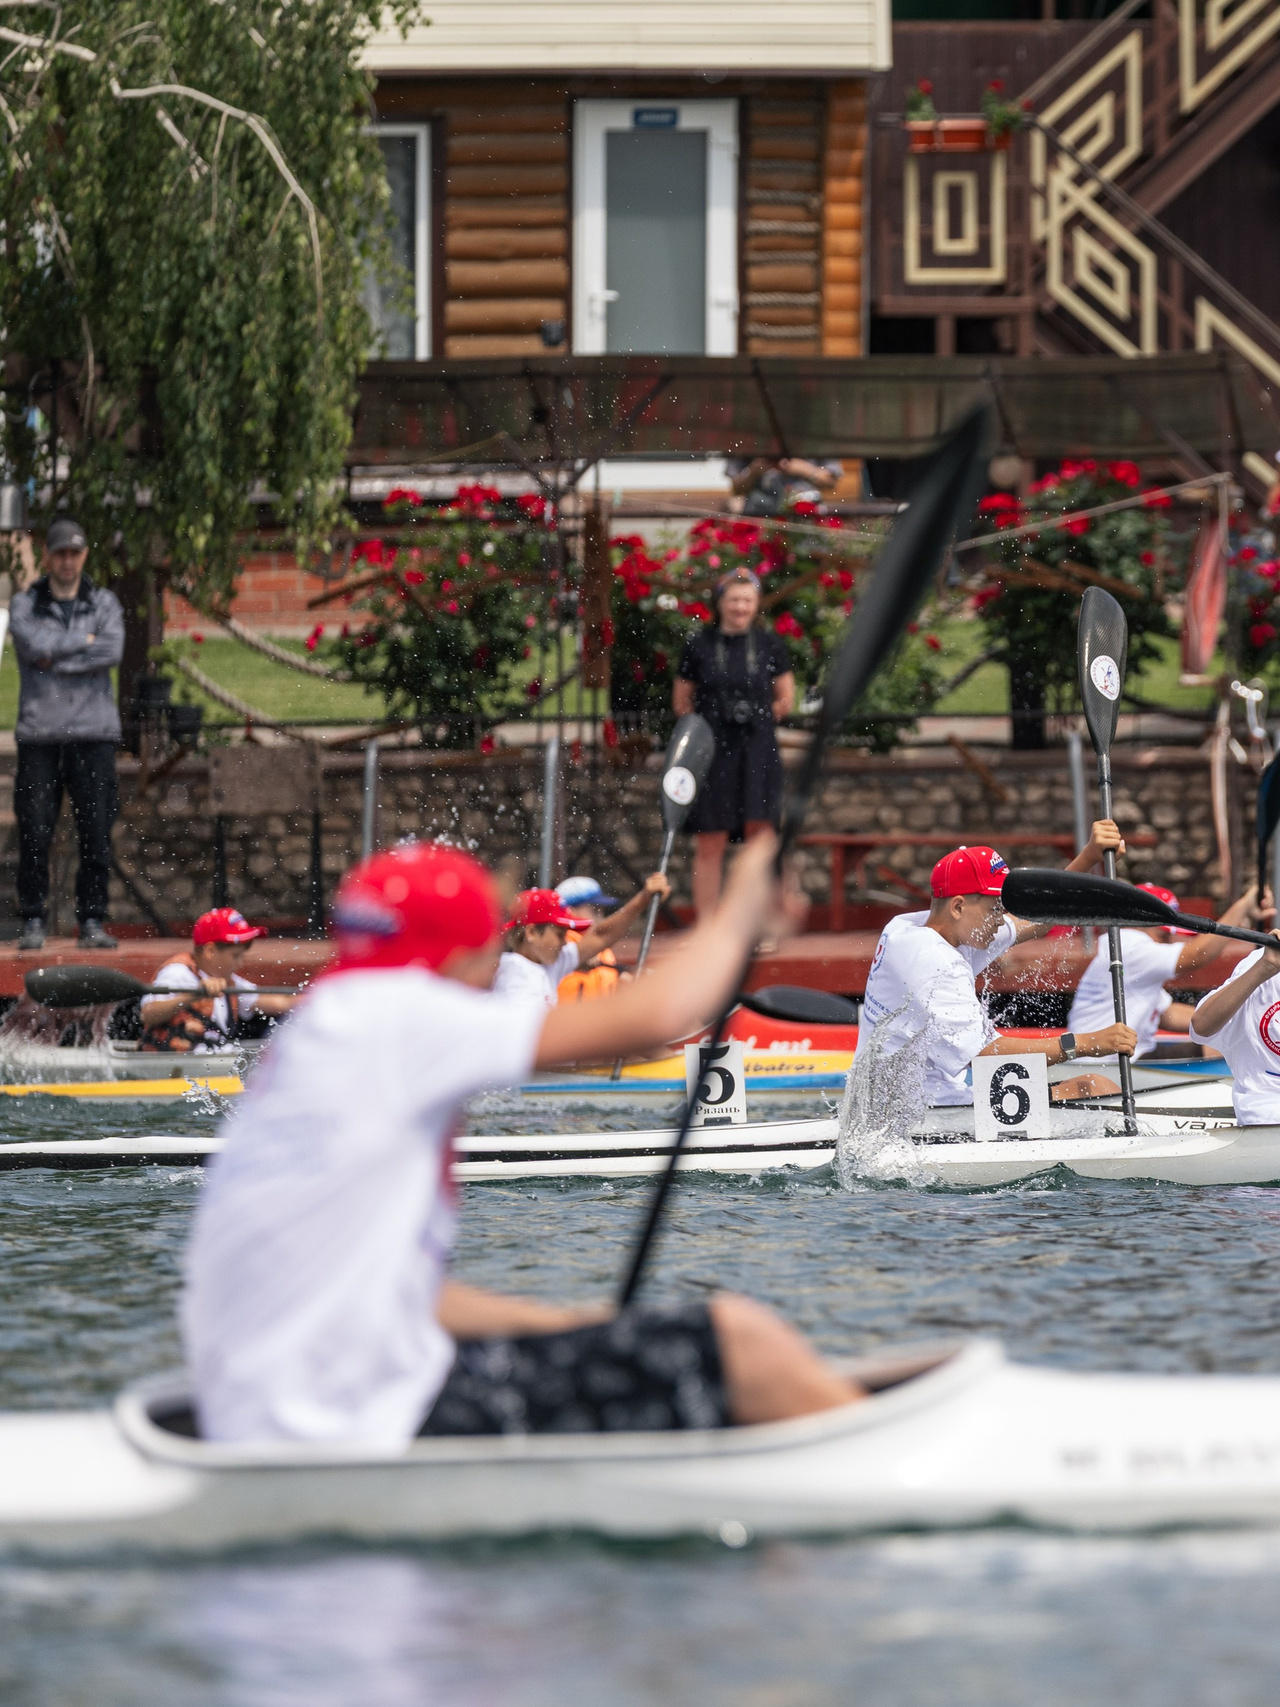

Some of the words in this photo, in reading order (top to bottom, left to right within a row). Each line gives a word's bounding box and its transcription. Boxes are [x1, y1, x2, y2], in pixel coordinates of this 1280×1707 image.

[696, 1045, 736, 1105] 5
[743, 1061, 815, 1073] lbatros
[694, 1105, 740, 1115] Рязань
[990, 1062, 1030, 1125] 6
